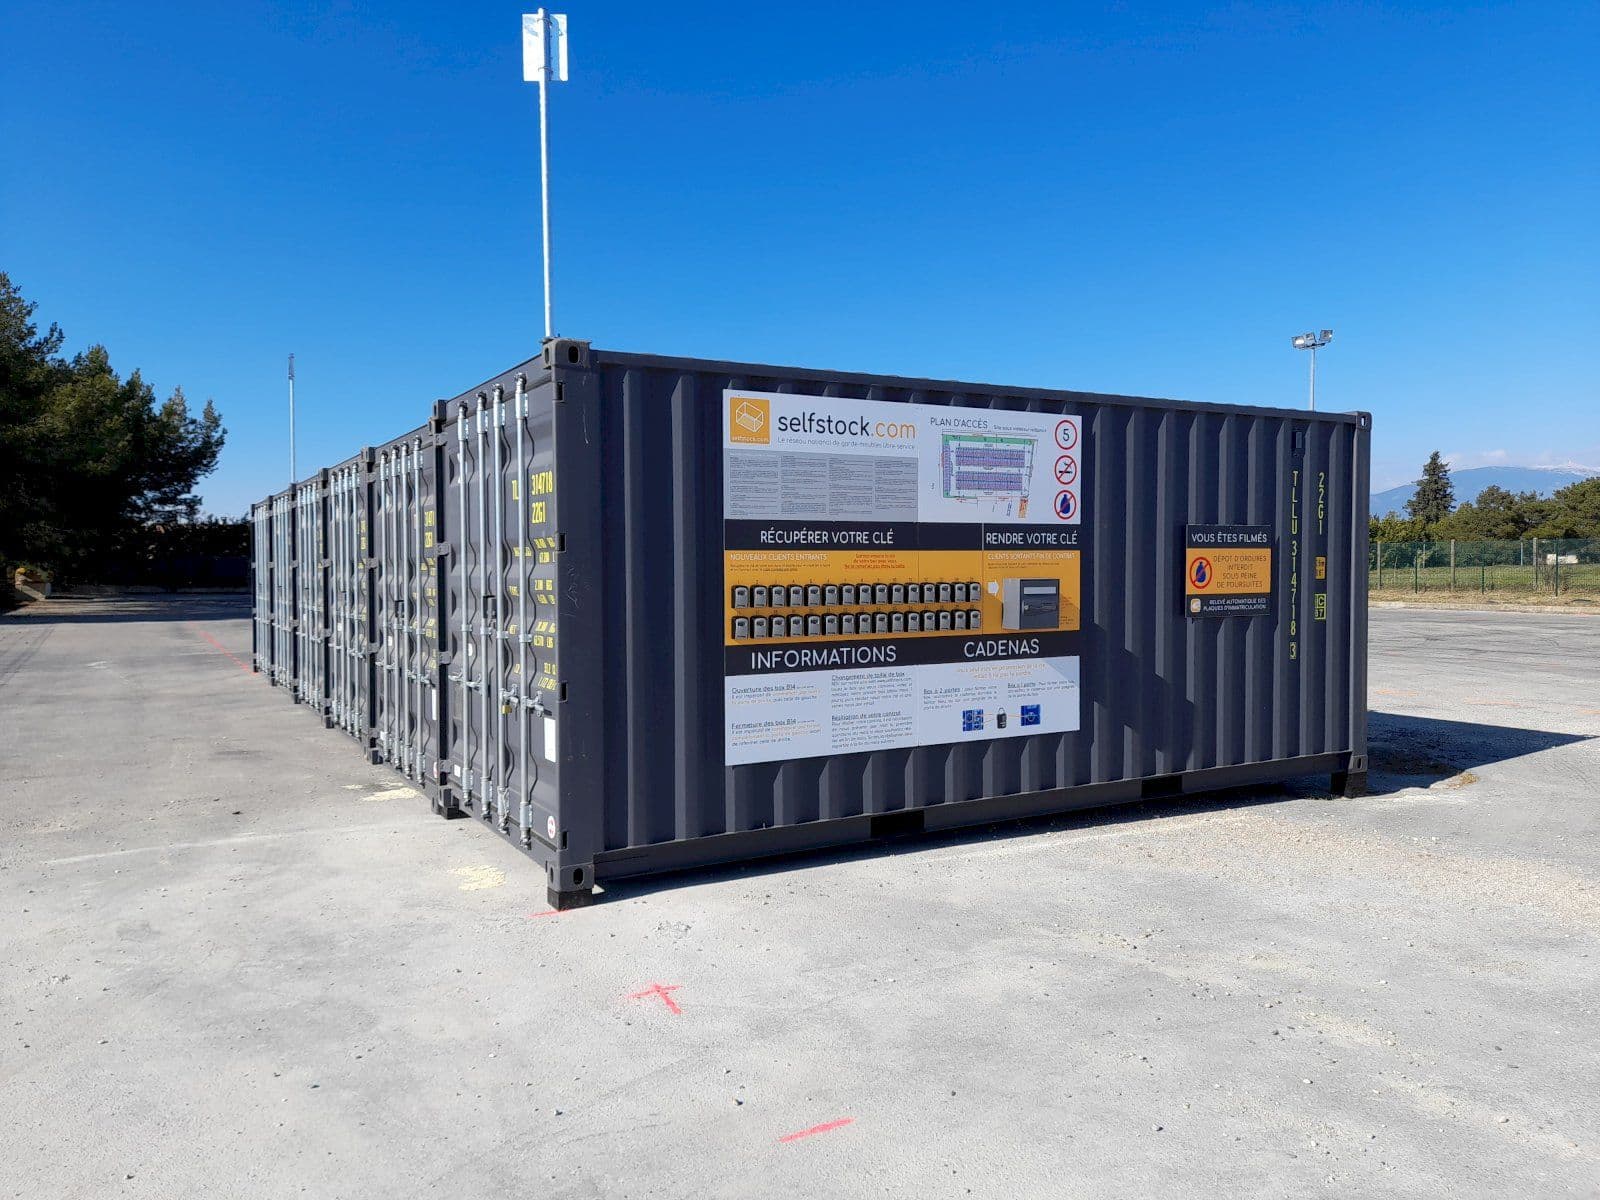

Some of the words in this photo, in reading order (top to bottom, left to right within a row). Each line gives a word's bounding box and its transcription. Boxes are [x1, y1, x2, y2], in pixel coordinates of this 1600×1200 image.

[777, 411, 916, 439] selfstock.com
[930, 416, 952, 427] PLAN
[953, 418, 988, 429] D'ACCÈS
[1062, 428, 1070, 442] 5
[531, 470, 553, 496] 314718
[531, 500, 546, 524] 22G1
[760, 528, 829, 545] RÉCUPÉRER
[831, 530, 870, 545] VOTRE
[872, 528, 894, 545] CLÉ
[985, 532, 1024, 545] RENDRE
[1025, 532, 1058, 545] VOTRE
[1059, 530, 1078, 545] CLÉ
[1191, 533, 1215, 543] VOUS
[1217, 531, 1237, 543] ÊTES
[1238, 531, 1267, 543] FILMÉS
[1227, 563, 1253, 571] INTERDIT
[1240, 571, 1257, 579] PEINE
[1226, 580, 1262, 588] POURSUITES
[964, 638, 1039, 657] CADENAS
[1290, 642, 1296, 659] 3
[751, 645, 897, 669] INFORMATIONS
[731, 722, 763, 730] Fermeture
